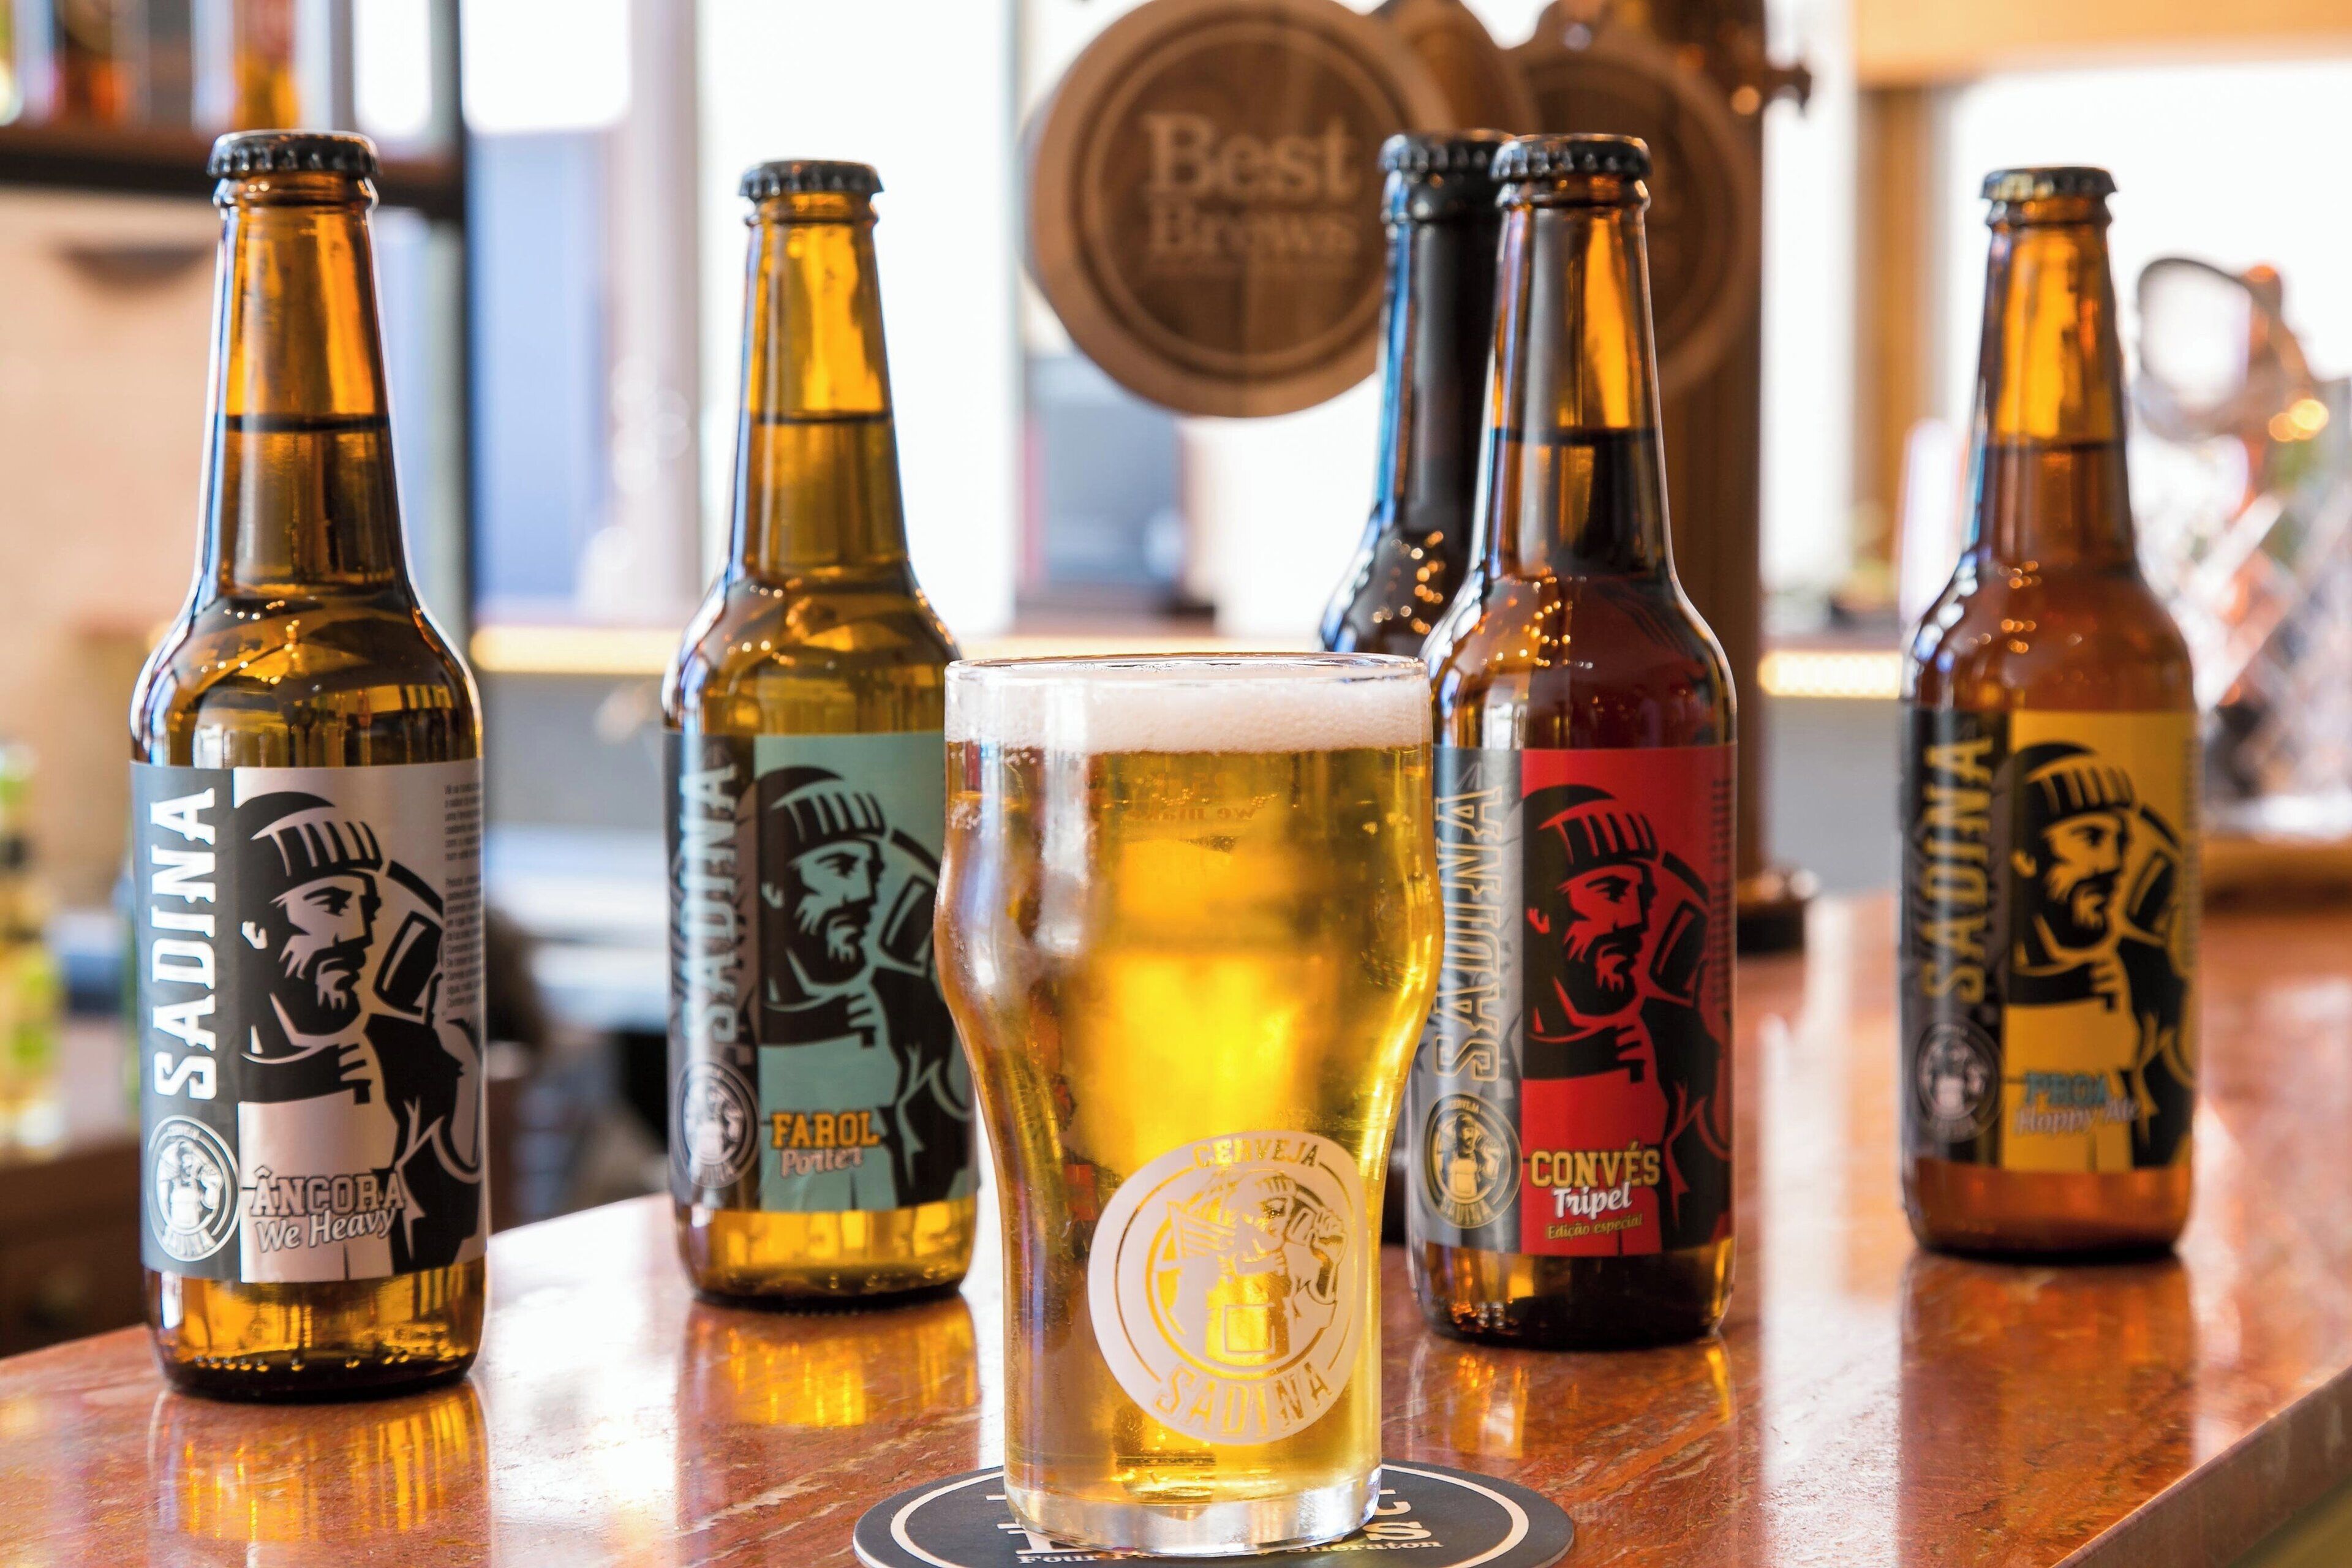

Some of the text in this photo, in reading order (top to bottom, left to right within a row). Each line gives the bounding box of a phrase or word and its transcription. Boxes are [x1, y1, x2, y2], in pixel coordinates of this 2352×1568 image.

[1143, 113, 1362, 203] Best
[1923, 734, 1994, 1005] SADINA
[677, 761, 738, 1044] SADINA
[149, 787, 217, 1102] SADINA
[1433, 784, 1503, 1083] SADINA
[772, 1110, 880, 1149] FAROL
[1191, 1137, 1321, 1168] CERVEJA
[1530, 1140, 1660, 1188] CONVÉS
[249, 1165, 405, 1217] ÂNCORA
[1553, 1180, 1633, 1220] Tripel
[255, 1207, 396, 1253] We Heavy
[1545, 1214, 1643, 1240] Edição especial
[1153, 1361, 1333, 1439] SADINA
[1017, 1553, 1099, 1564] Four
